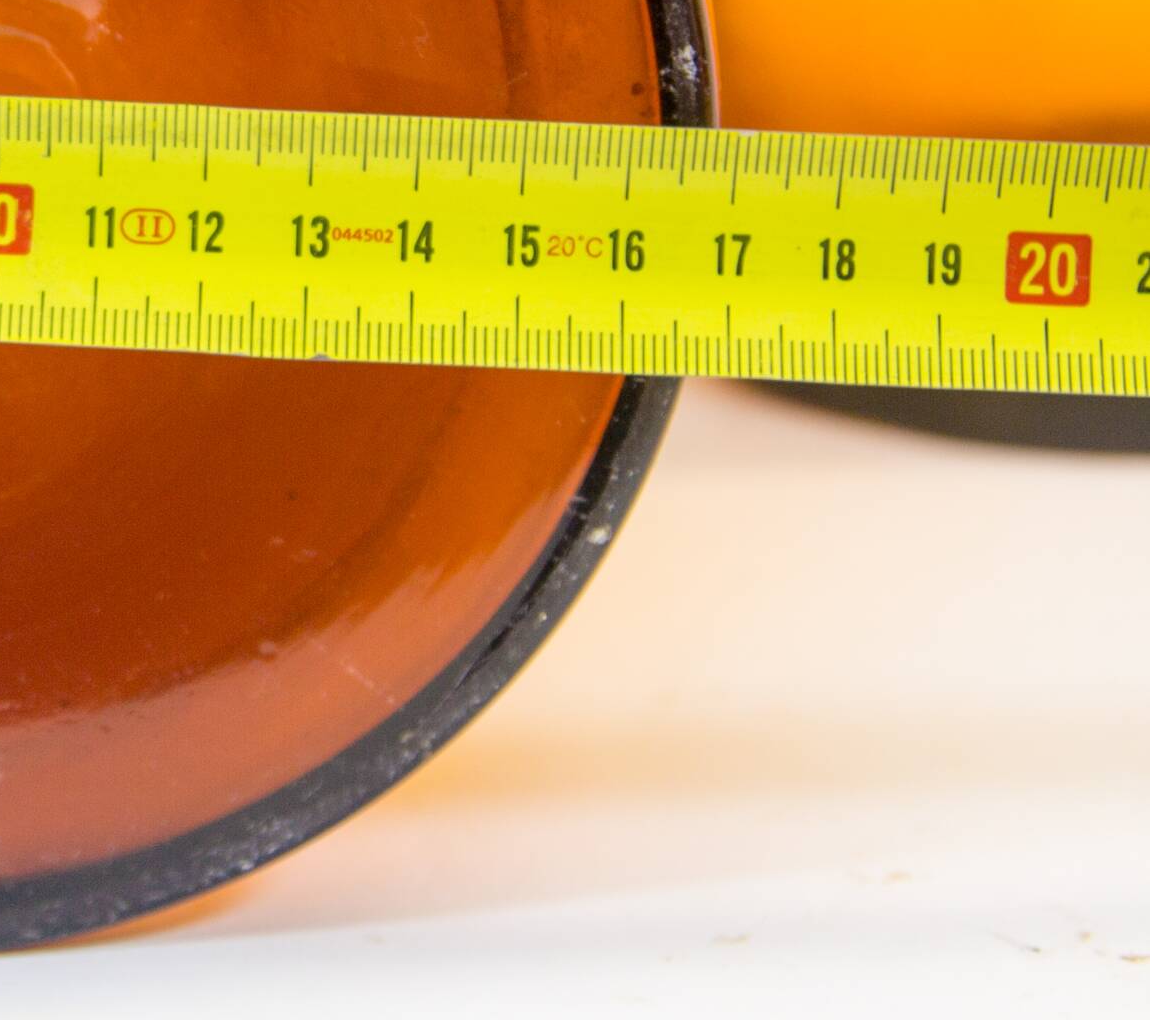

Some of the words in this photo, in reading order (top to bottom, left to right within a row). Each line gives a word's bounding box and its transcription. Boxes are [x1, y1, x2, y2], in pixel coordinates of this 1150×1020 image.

[86, 206, 115, 248] 11
[188, 211, 224, 253] 12
[292, 215, 329, 258] 13
[332, 227, 394, 244] 044502
[398, 220, 434, 262] 14
[504, 224, 540, 267] 15
[609, 229, 645, 271] 16
[714, 234, 751, 276] 17
[819, 239, 855, 281] 18
[925, 243, 961, 286] 19
[1018, 241, 1078, 297] 20
